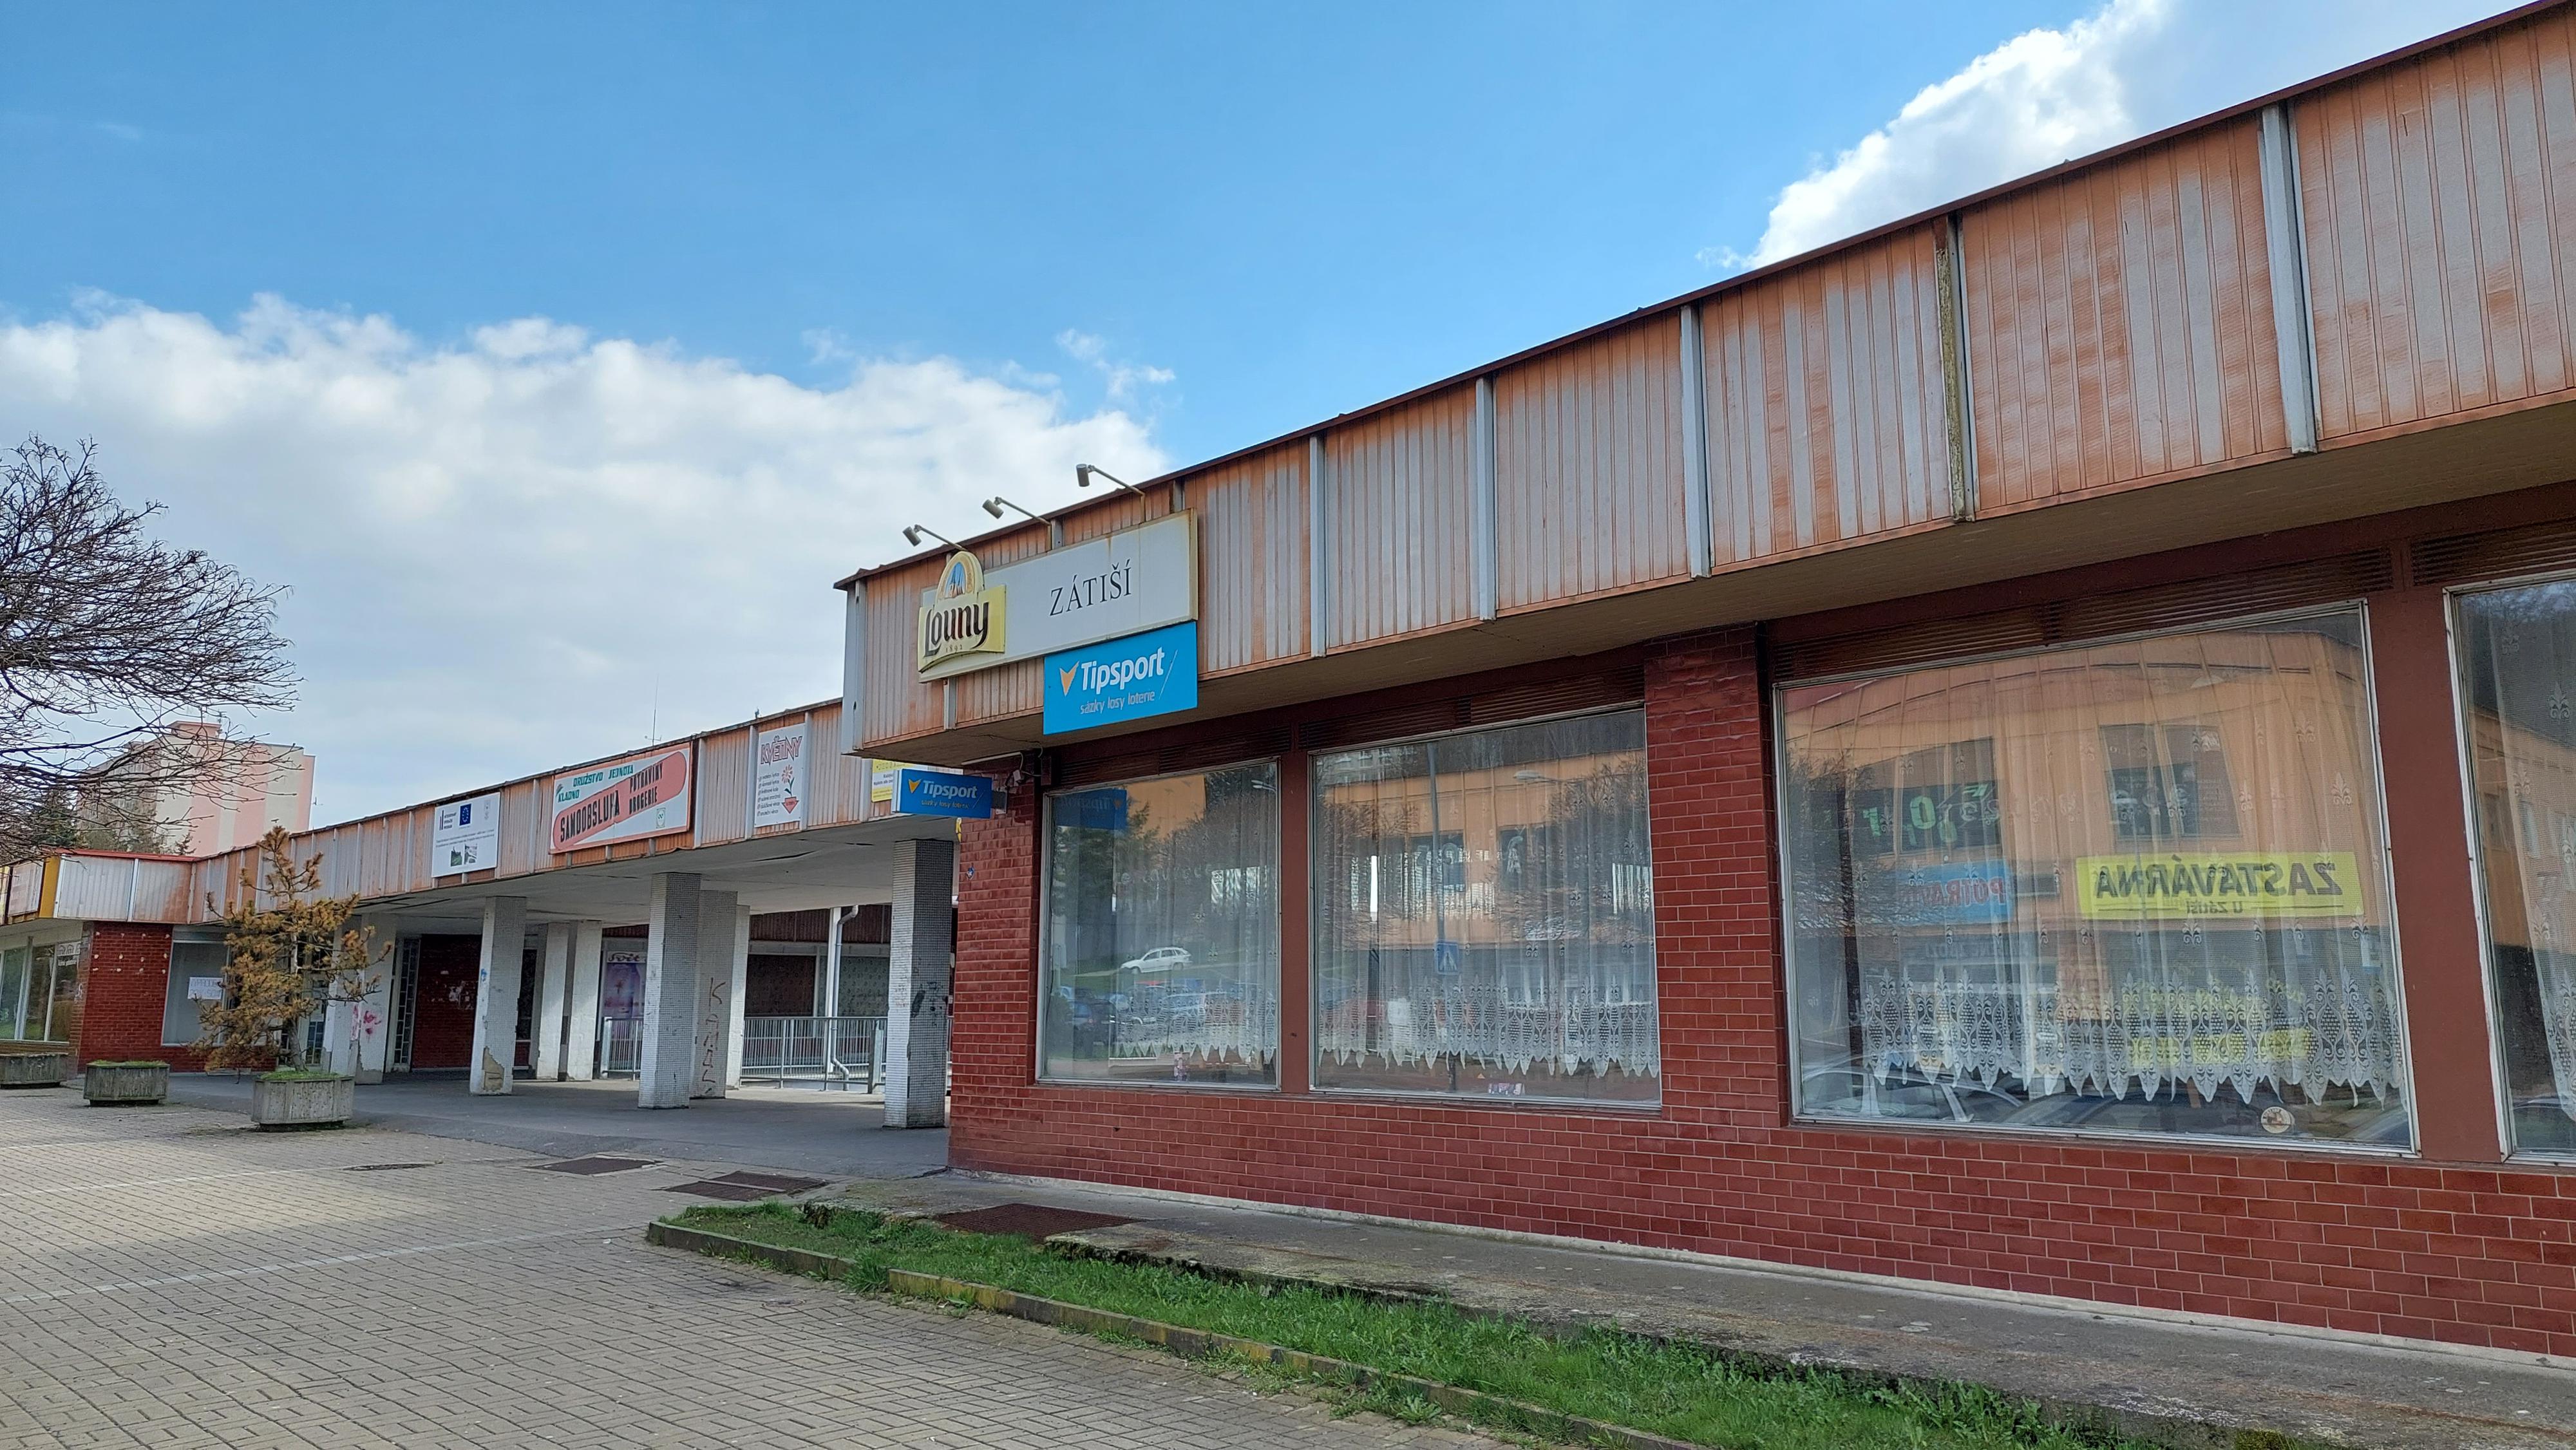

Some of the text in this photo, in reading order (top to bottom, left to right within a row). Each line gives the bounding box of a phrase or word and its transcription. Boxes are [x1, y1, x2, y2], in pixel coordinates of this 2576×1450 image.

[1050, 559, 1132, 616] ZÁTIŠÍ
[923, 601, 989, 657] Louny
[1081, 646, 1164, 695] Tipsport
[1107, 696, 1125, 710] losy
[761, 735, 803, 767] KVĚTINY
[573, 764, 634, 787] DRUŽSTVO JEDNOTA
[630, 762, 663, 794] POTRAVINY
[923, 780, 978, 799] Tipsport
[558, 789, 580, 803] KLADNO
[629, 786, 658, 815] DROGERIE
